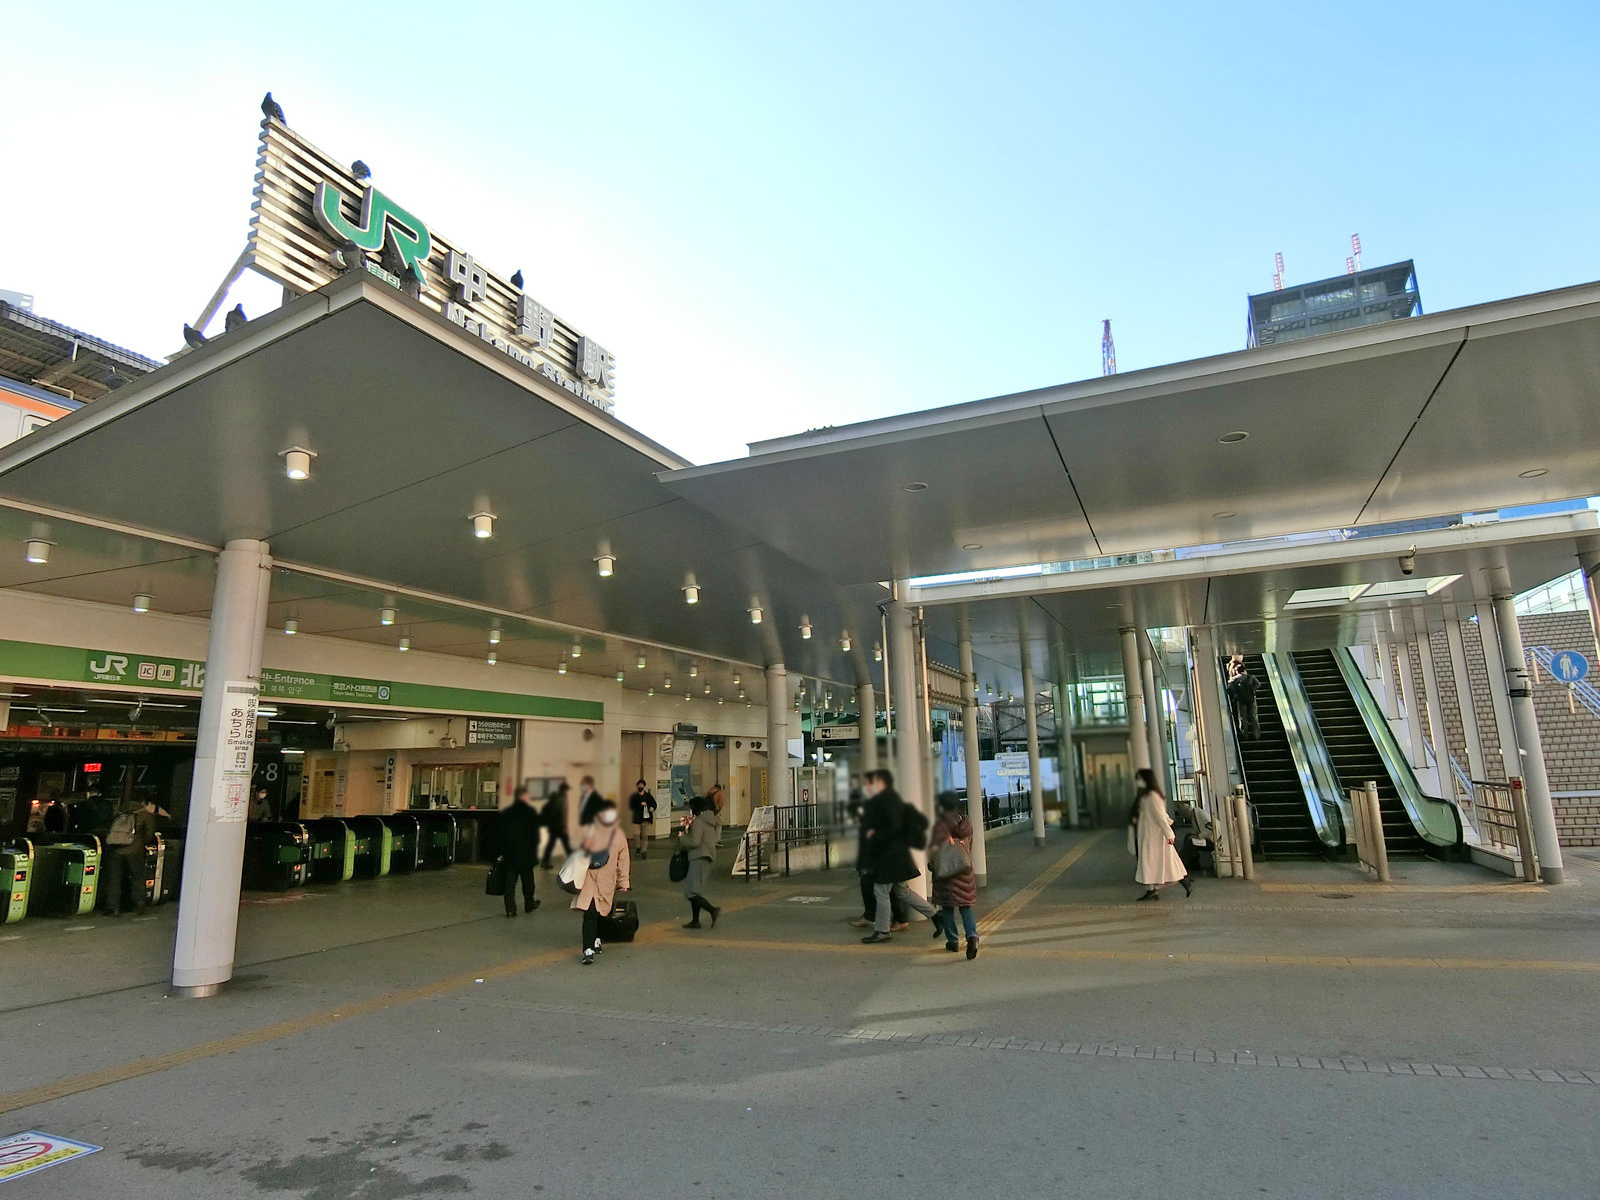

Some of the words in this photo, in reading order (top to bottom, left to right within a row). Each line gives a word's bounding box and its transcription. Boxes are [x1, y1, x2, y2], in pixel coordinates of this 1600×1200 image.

[314, 181, 431, 291] JR
[445, 250, 609, 389] 中野駅
[447, 302, 534, 368] Nakano
[538, 362, 608, 412] Station
[90, 655, 128, 675] JR
[275, 673, 315, 686] Entrance
[333, 682, 377, 694] 東京メトロ東西線
[230, 708, 243, 738] あちら
[245, 698, 257, 738] 喫煙所は
